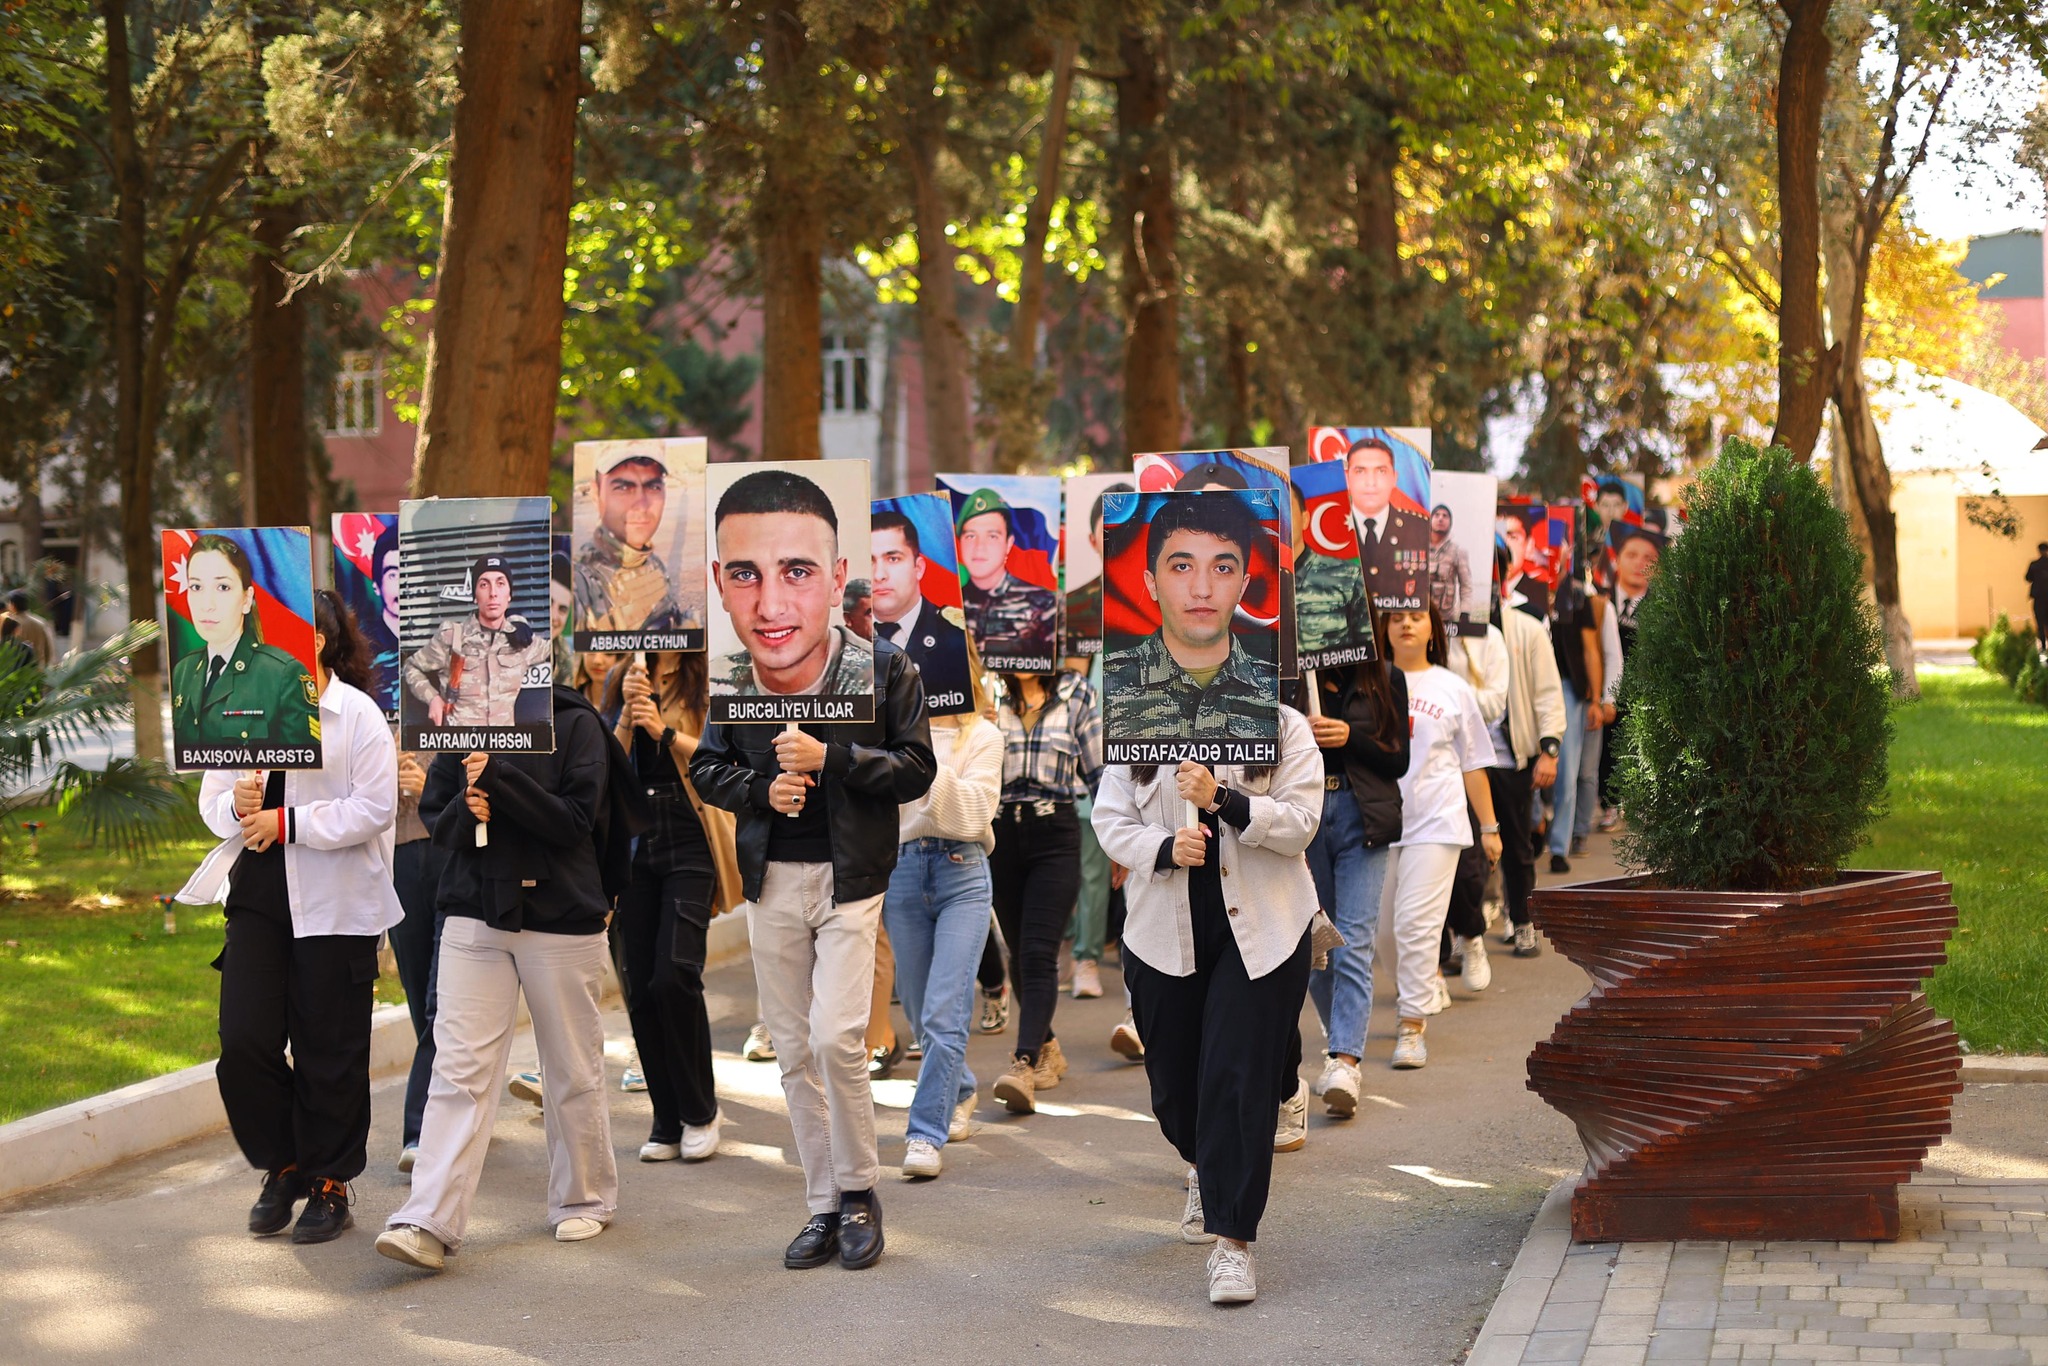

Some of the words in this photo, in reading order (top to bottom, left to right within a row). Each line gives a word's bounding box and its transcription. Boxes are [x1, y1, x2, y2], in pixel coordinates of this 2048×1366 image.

[1373, 596, 1421, 609] NQİLAB
[590, 636, 641, 651] ABBASOV
[643, 635, 688, 649] CEYHUN
[1298, 654, 1320, 671] ROV
[1322, 646, 1368, 667] BƏHRUZ
[925, 690, 965, 708] ƏRİD
[728, 698, 810, 719] BURCƏLİYEV
[813, 698, 854, 718] İLQAR
[1408, 697, 1444, 720] GELES
[419, 732, 487, 749] BAYRAMOV
[489, 732, 532, 749] HƏSƏN
[182, 749, 253, 767] BAXIŞOVA
[256, 749, 315, 763] ARƏSTƏ
[1107, 744, 1221, 761] MUSTAFAZADƏ
[1225, 744, 1275, 760] TALEH
